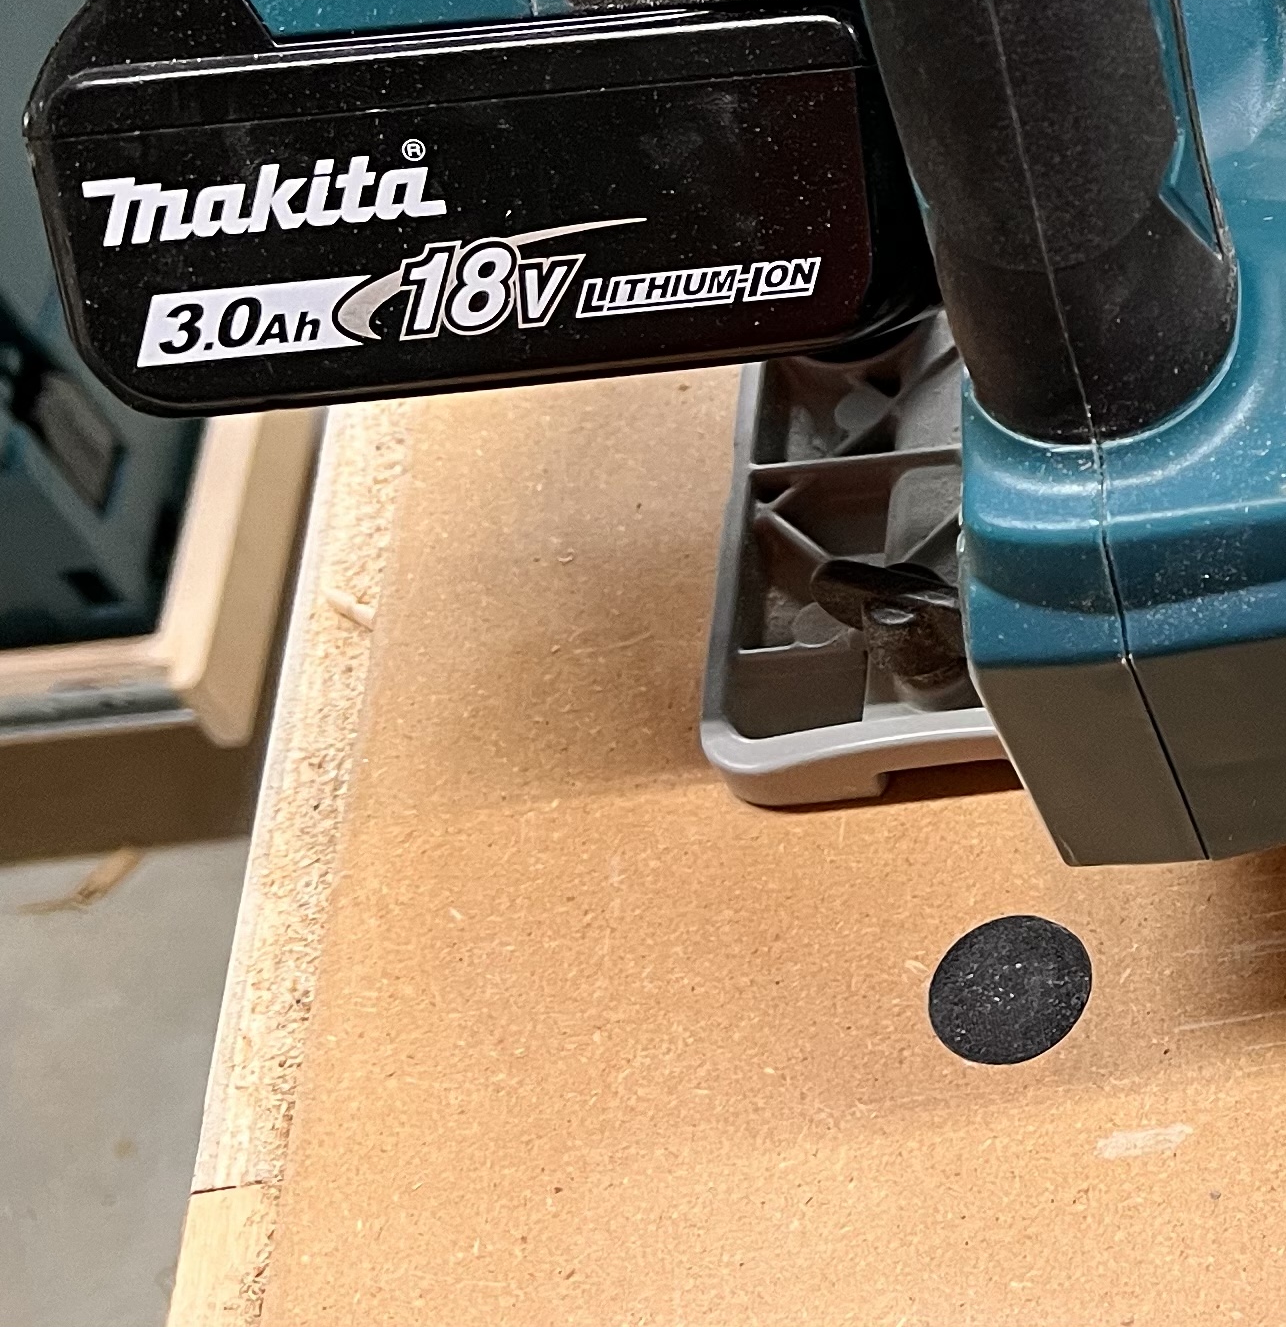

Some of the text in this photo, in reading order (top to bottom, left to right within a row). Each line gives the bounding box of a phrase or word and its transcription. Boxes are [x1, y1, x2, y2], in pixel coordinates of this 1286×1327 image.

[158, 239, 820, 355] 3.0Ah 18V LITHIUM-ION
